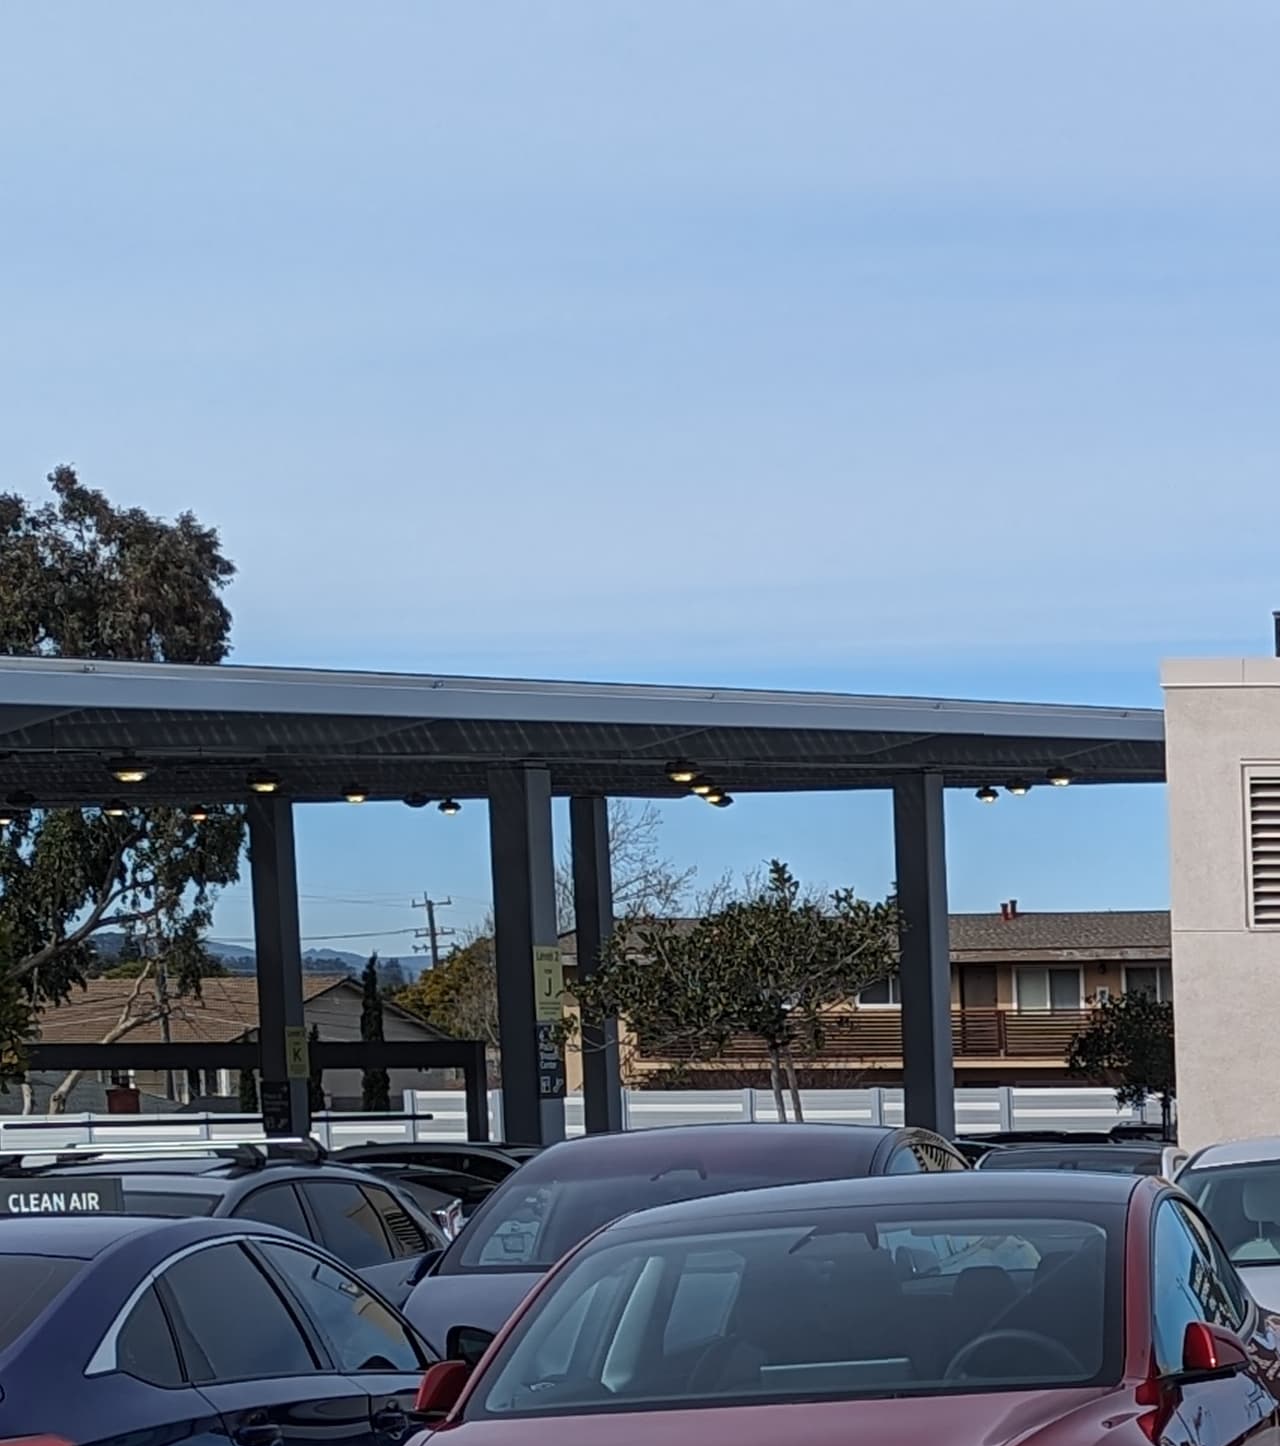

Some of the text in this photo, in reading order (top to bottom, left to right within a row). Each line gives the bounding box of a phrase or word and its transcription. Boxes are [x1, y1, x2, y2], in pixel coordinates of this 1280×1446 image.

[544, 977, 552, 997] J
[293, 1047, 302, 1062] K
[8, 1192, 100, 1213] CLEAN AIR
